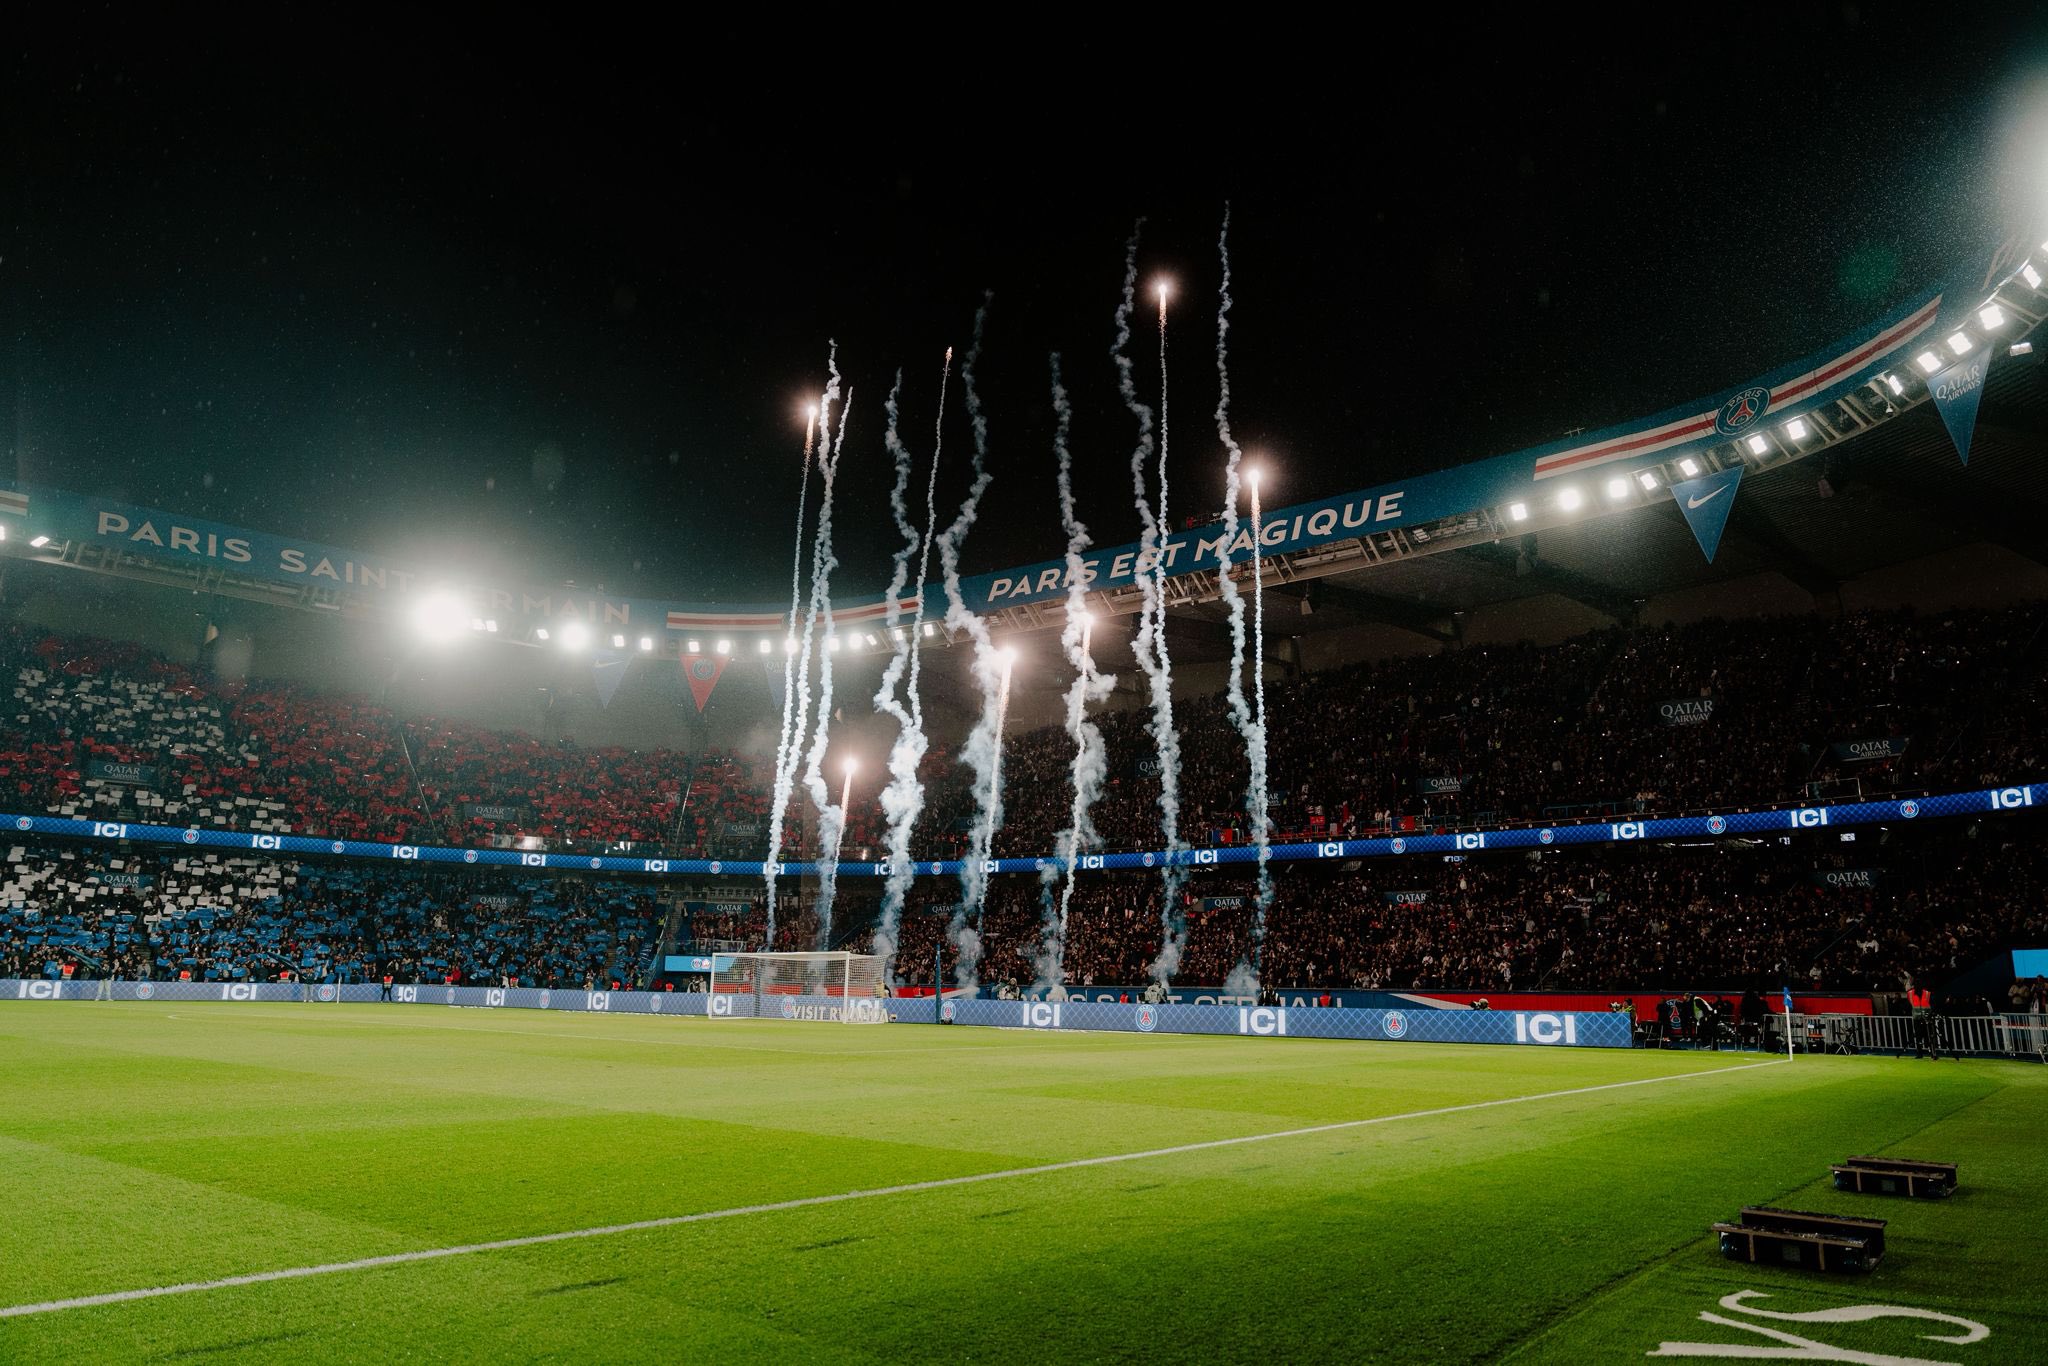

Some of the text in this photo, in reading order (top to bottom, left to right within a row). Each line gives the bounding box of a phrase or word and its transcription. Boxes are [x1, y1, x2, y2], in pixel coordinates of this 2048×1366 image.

[1936, 365, 1980, 400] QATAR
[1947, 377, 1981, 402] AIRWAYS
[1728, 390, 1762, 407] PARIS
[97, 511, 252, 562] PARIS
[280, 549, 414, 592] SAINT
[986, 492, 1404, 602] PARIS EST MAGIQUE
[1661, 700, 1713, 719] QATAR
[1850, 740, 1890, 754] QATAR
[1860, 749, 1891, 758] AIRWAYS
[104, 764, 140, 776] QATAR
[1991, 787, 2032, 809] ICI
[476, 806, 504, 815] QATAR
[1791, 809, 1828, 828] ICI
[94, 822, 127, 838] ICI
[1612, 822, 1644, 840] ICI
[252, 835, 281, 849] ICI
[1456, 833, 1485, 849] ICI
[393, 845, 419, 859] ICI
[1195, 850, 1218, 864] ICI
[1318, 842, 1343, 857] ICI
[522, 853, 546, 867] ICI
[644, 860, 668, 872] ICI
[979, 860, 999, 873] ICI
[1082, 855, 1104, 869] ICI
[763, 862, 785, 875] ICI
[874, 863, 896, 875] ICI
[104, 874, 140, 885] QATAR
[1827, 872, 1869, 885] QATAR
[480, 896, 507, 905] QATAR
[1215, 899, 1240, 908] QATAR
[1396, 893, 1426, 903] QATAR
[717, 904, 742, 912] QATAR
[18, 981, 62, 999] ICI
[222, 984, 257, 1000] ICI
[398, 986, 417, 1002] ICI
[486, 989, 505, 1006] ICI
[587, 992, 609, 1010] ICI
[792, 1005, 827, 1020] VISIT
[1022, 1003, 1060, 1026] ICI
[1239, 1008, 1285, 1034] ICI
[1515, 1013, 1576, 1043] ICI
